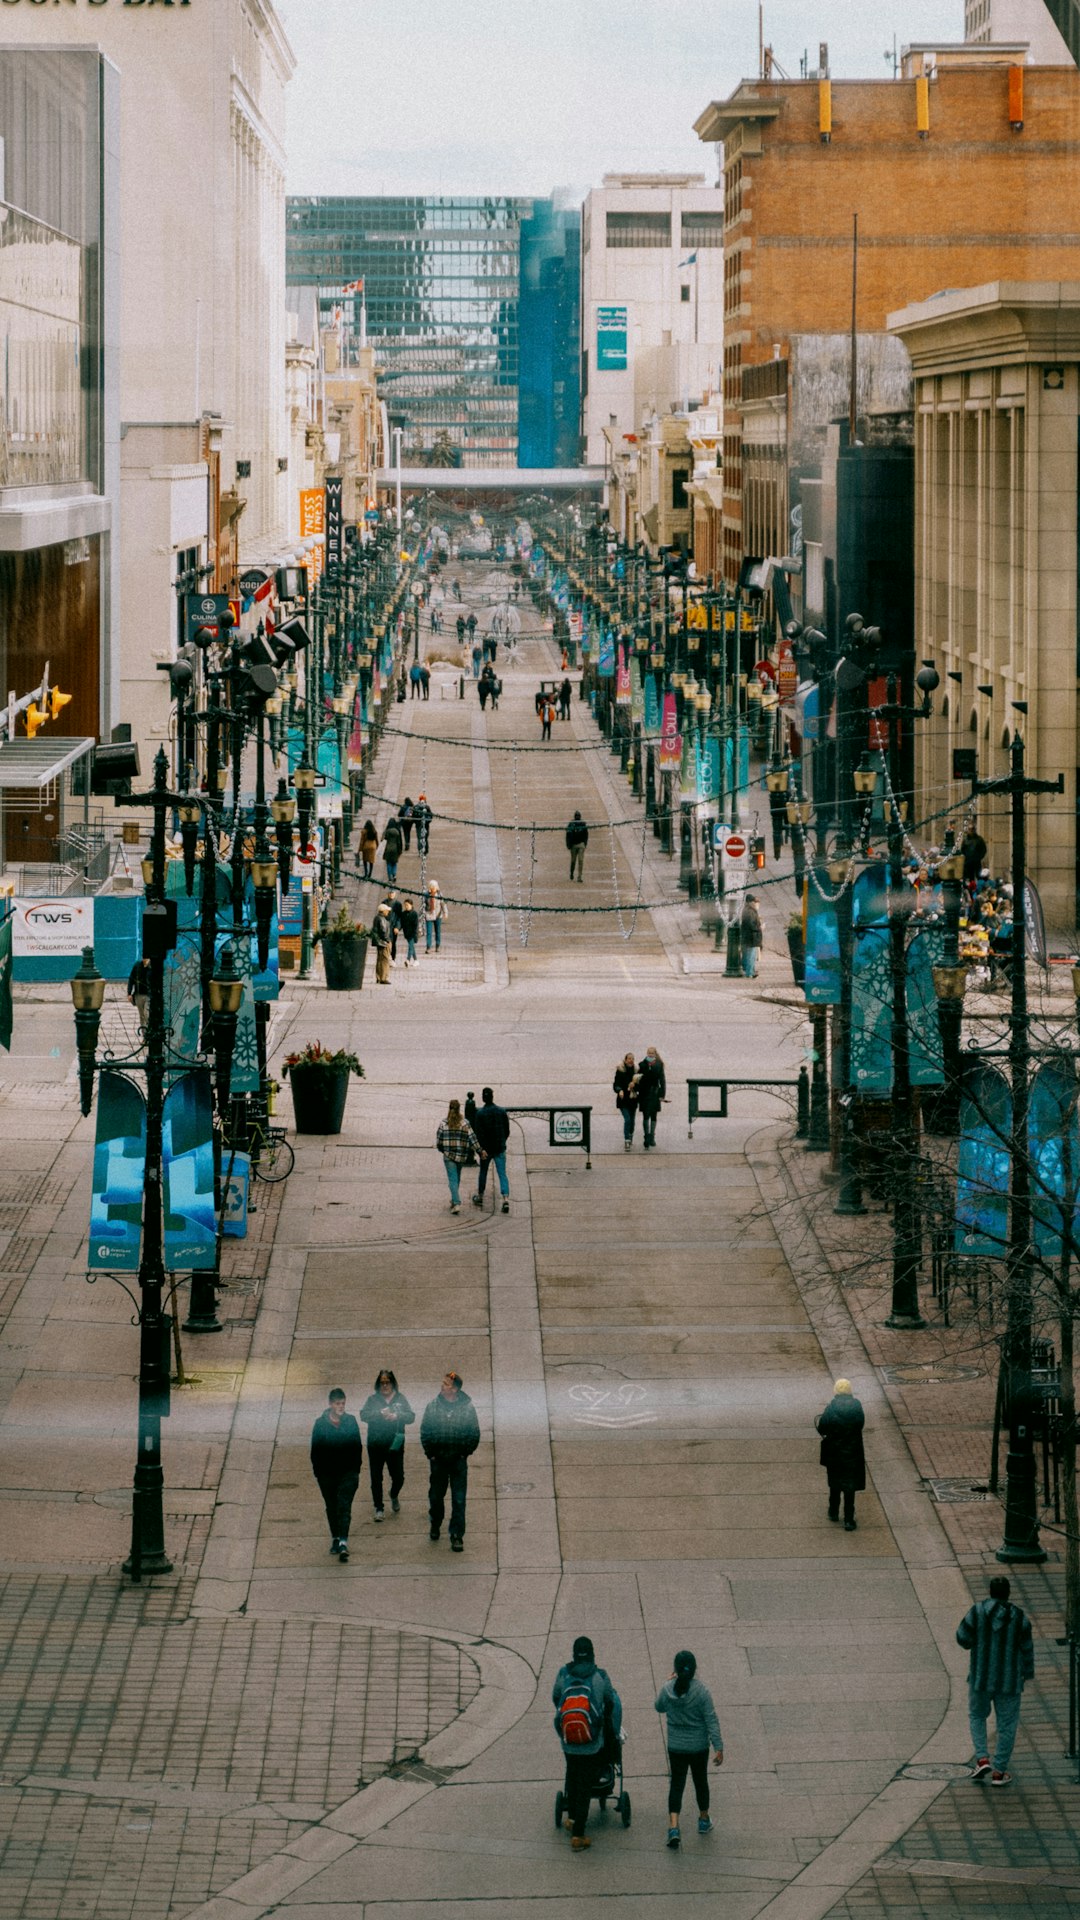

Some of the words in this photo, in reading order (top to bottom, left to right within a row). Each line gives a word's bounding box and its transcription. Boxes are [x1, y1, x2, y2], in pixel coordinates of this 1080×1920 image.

[304, 494, 315, 537] TNESS
[240, 581, 261, 589] SOCI
[666, 712, 677, 751] GLOW
[31, 913, 72, 923] TWS
